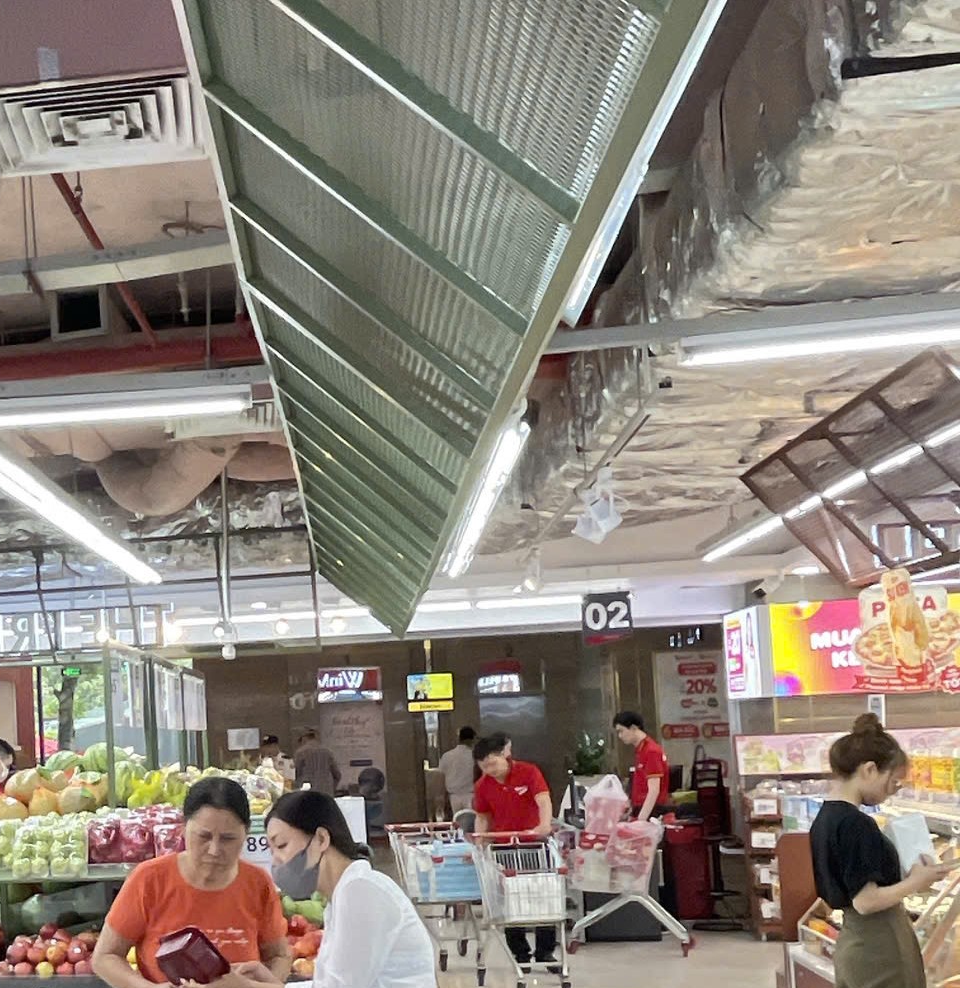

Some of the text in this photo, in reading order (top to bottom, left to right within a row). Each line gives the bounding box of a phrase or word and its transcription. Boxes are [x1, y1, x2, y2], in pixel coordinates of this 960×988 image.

[584, 600, 630, 631] 02
[686, 680, 717, 694] 20%
[247, 836, 270, 852] 89
